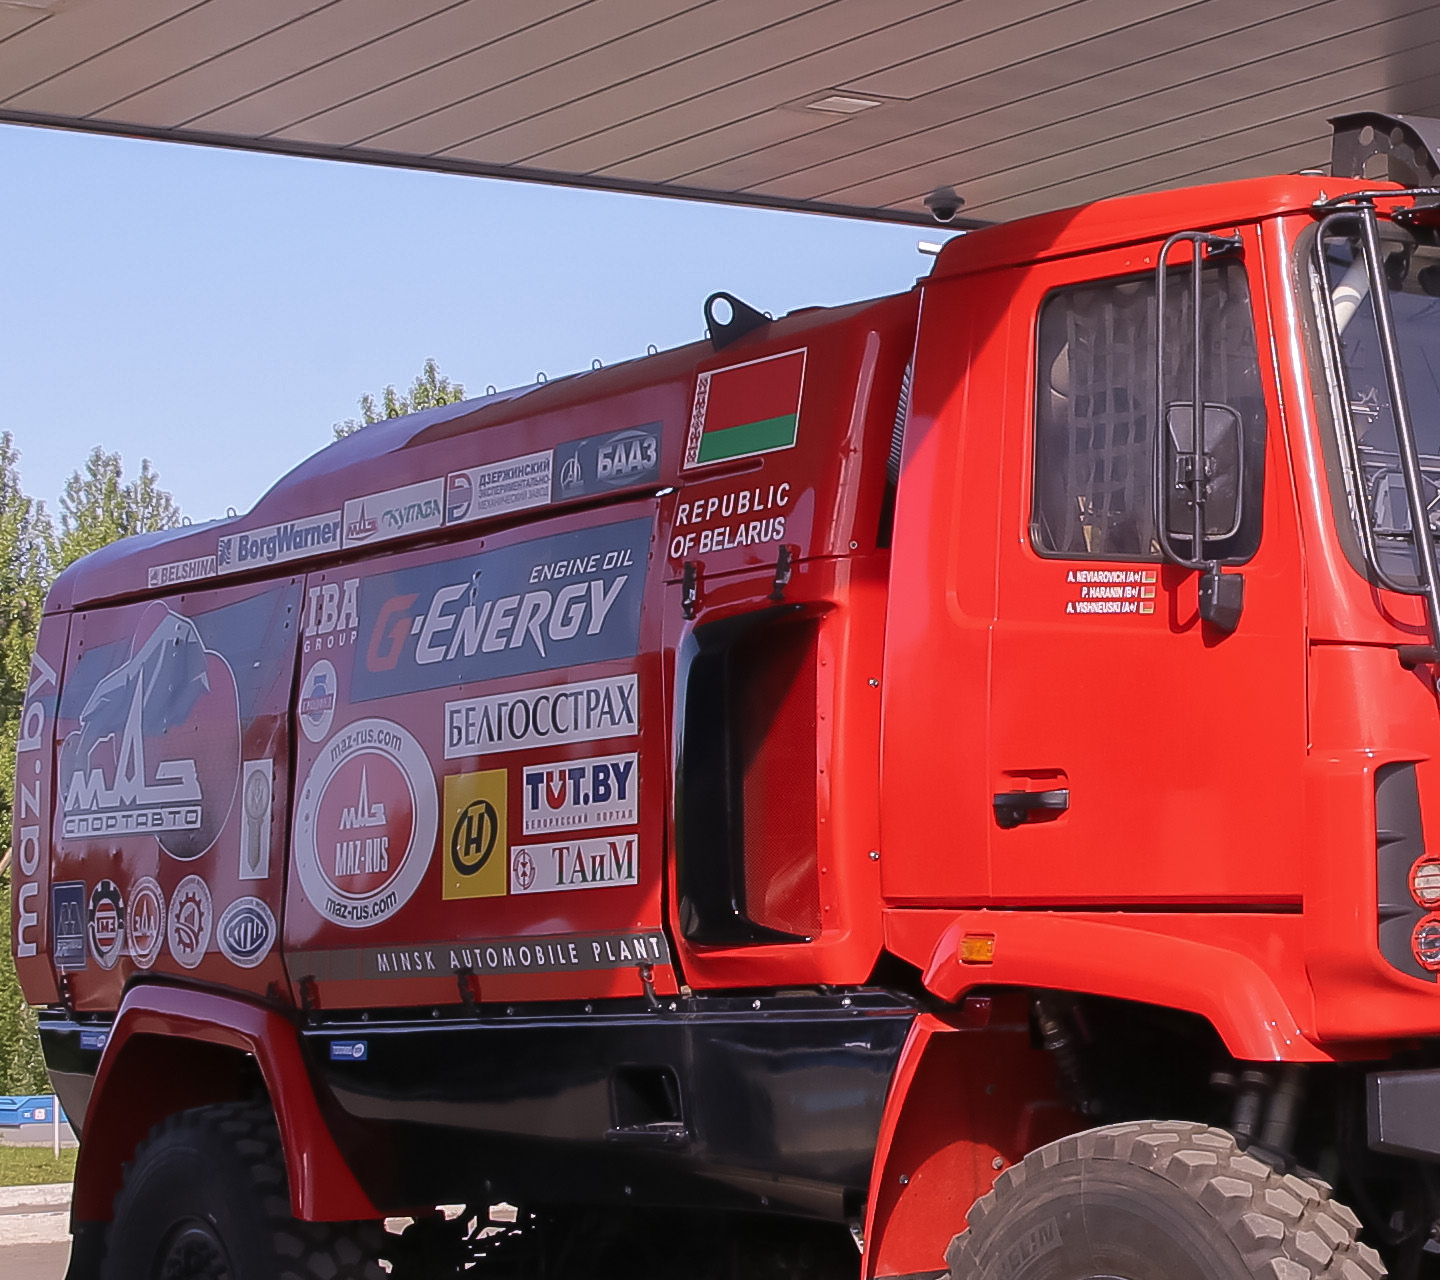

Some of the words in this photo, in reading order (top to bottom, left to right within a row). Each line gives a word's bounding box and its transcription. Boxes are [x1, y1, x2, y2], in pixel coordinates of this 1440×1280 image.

[478, 457, 551, 489] ДЗЕРЖИНСКИЙ
[597, 427, 658, 480] БААЗ
[676, 483, 790, 527] REPUBLIC
[237, 521, 341, 563] BorgWarner
[671, 533, 698, 558] OF
[699, 517, 786, 554] BELARUS
[161, 560, 216, 585] BELSHINA
[528, 554, 601, 584] ENGINE
[602, 549, 634, 571] OIL
[305, 578, 360, 637] IBA
[304, 631, 358, 653] GROUP
[449, 683, 635, 748] БЕЛГОССТРАХ
[330, 727, 403, 763] maz-rus.com
[16, 651, 57, 958] maz.by
[525, 760, 634, 811] TUT.BY
[64, 809, 199, 834] СПОРТАВТО
[596, 808, 634, 823] ПОРТАЛ
[334, 836, 390, 878] MAZ-RUS
[324, 890, 398, 921] maz-rus.com
[377, 950, 436, 973] MINSK
[449, 942, 579, 970] AUTOMOBILE
[591, 936, 660, 962] PLANT
